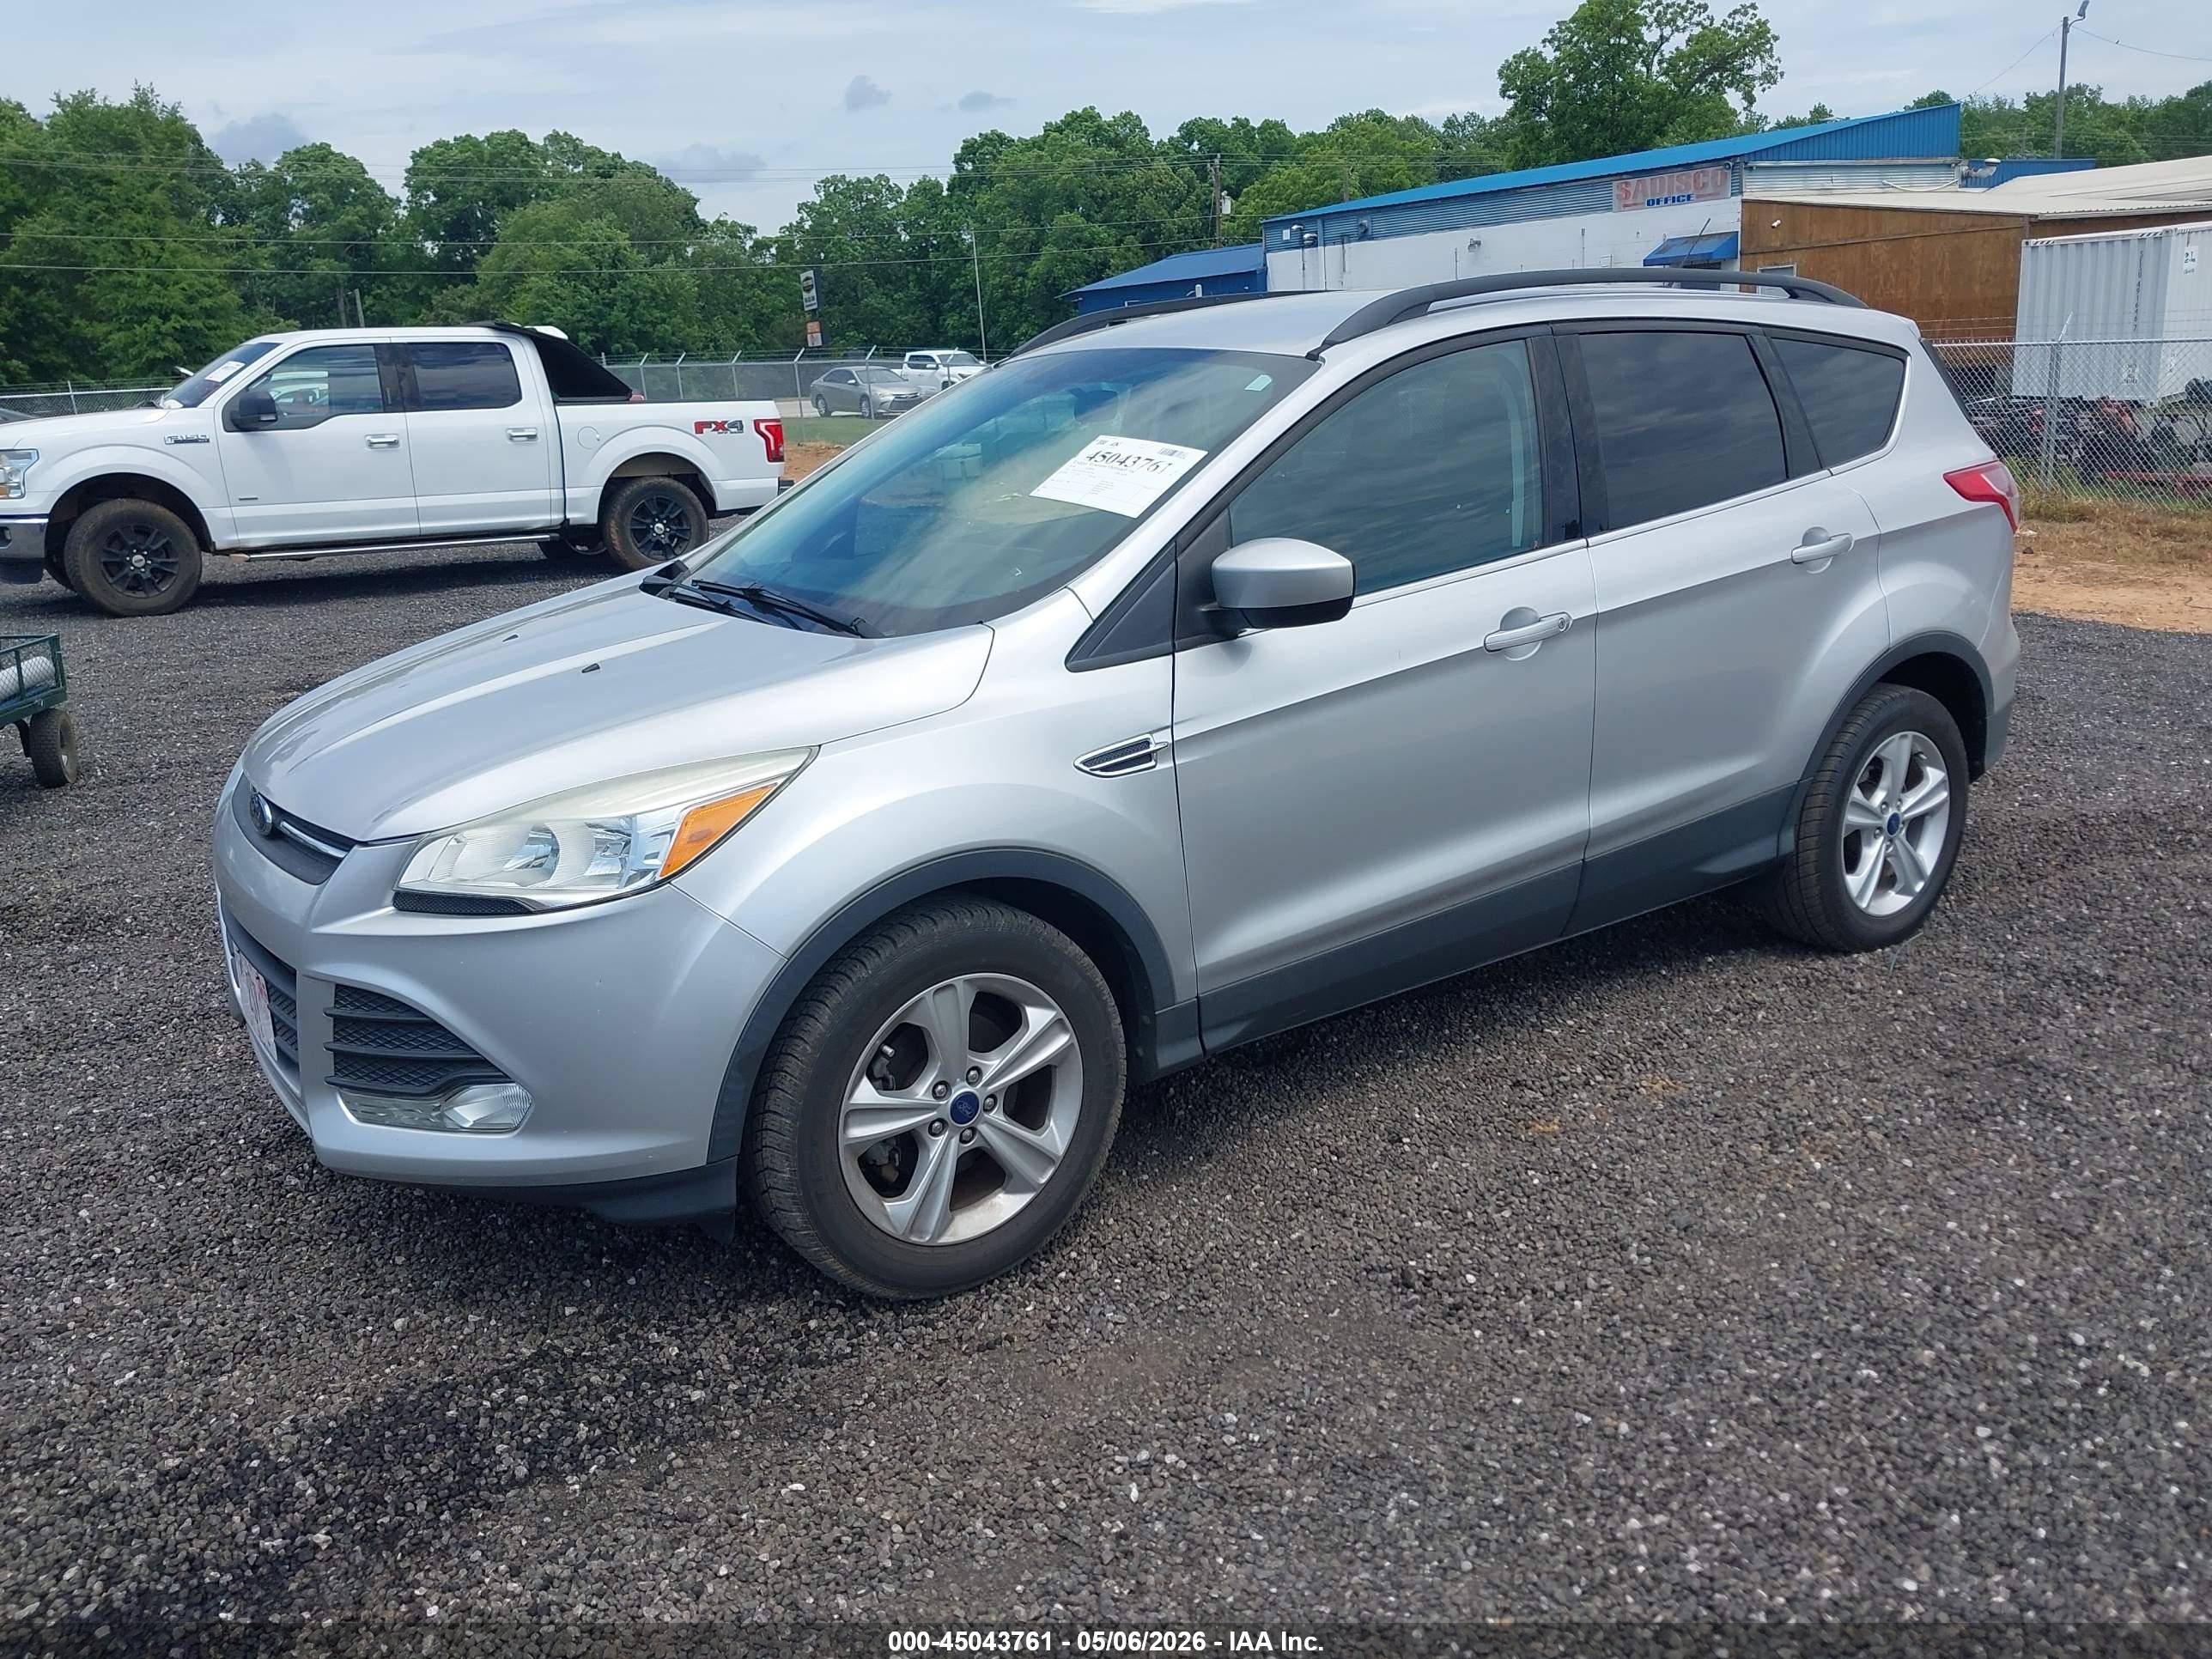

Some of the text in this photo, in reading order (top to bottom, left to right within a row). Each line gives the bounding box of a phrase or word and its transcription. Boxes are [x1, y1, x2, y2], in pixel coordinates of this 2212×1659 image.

[1617, 168, 1728, 201] SADISCO
[1646, 192, 1695, 207] OFFICE
[694, 420, 744, 434] FX4
[1085, 450, 1173, 475] 45043761
